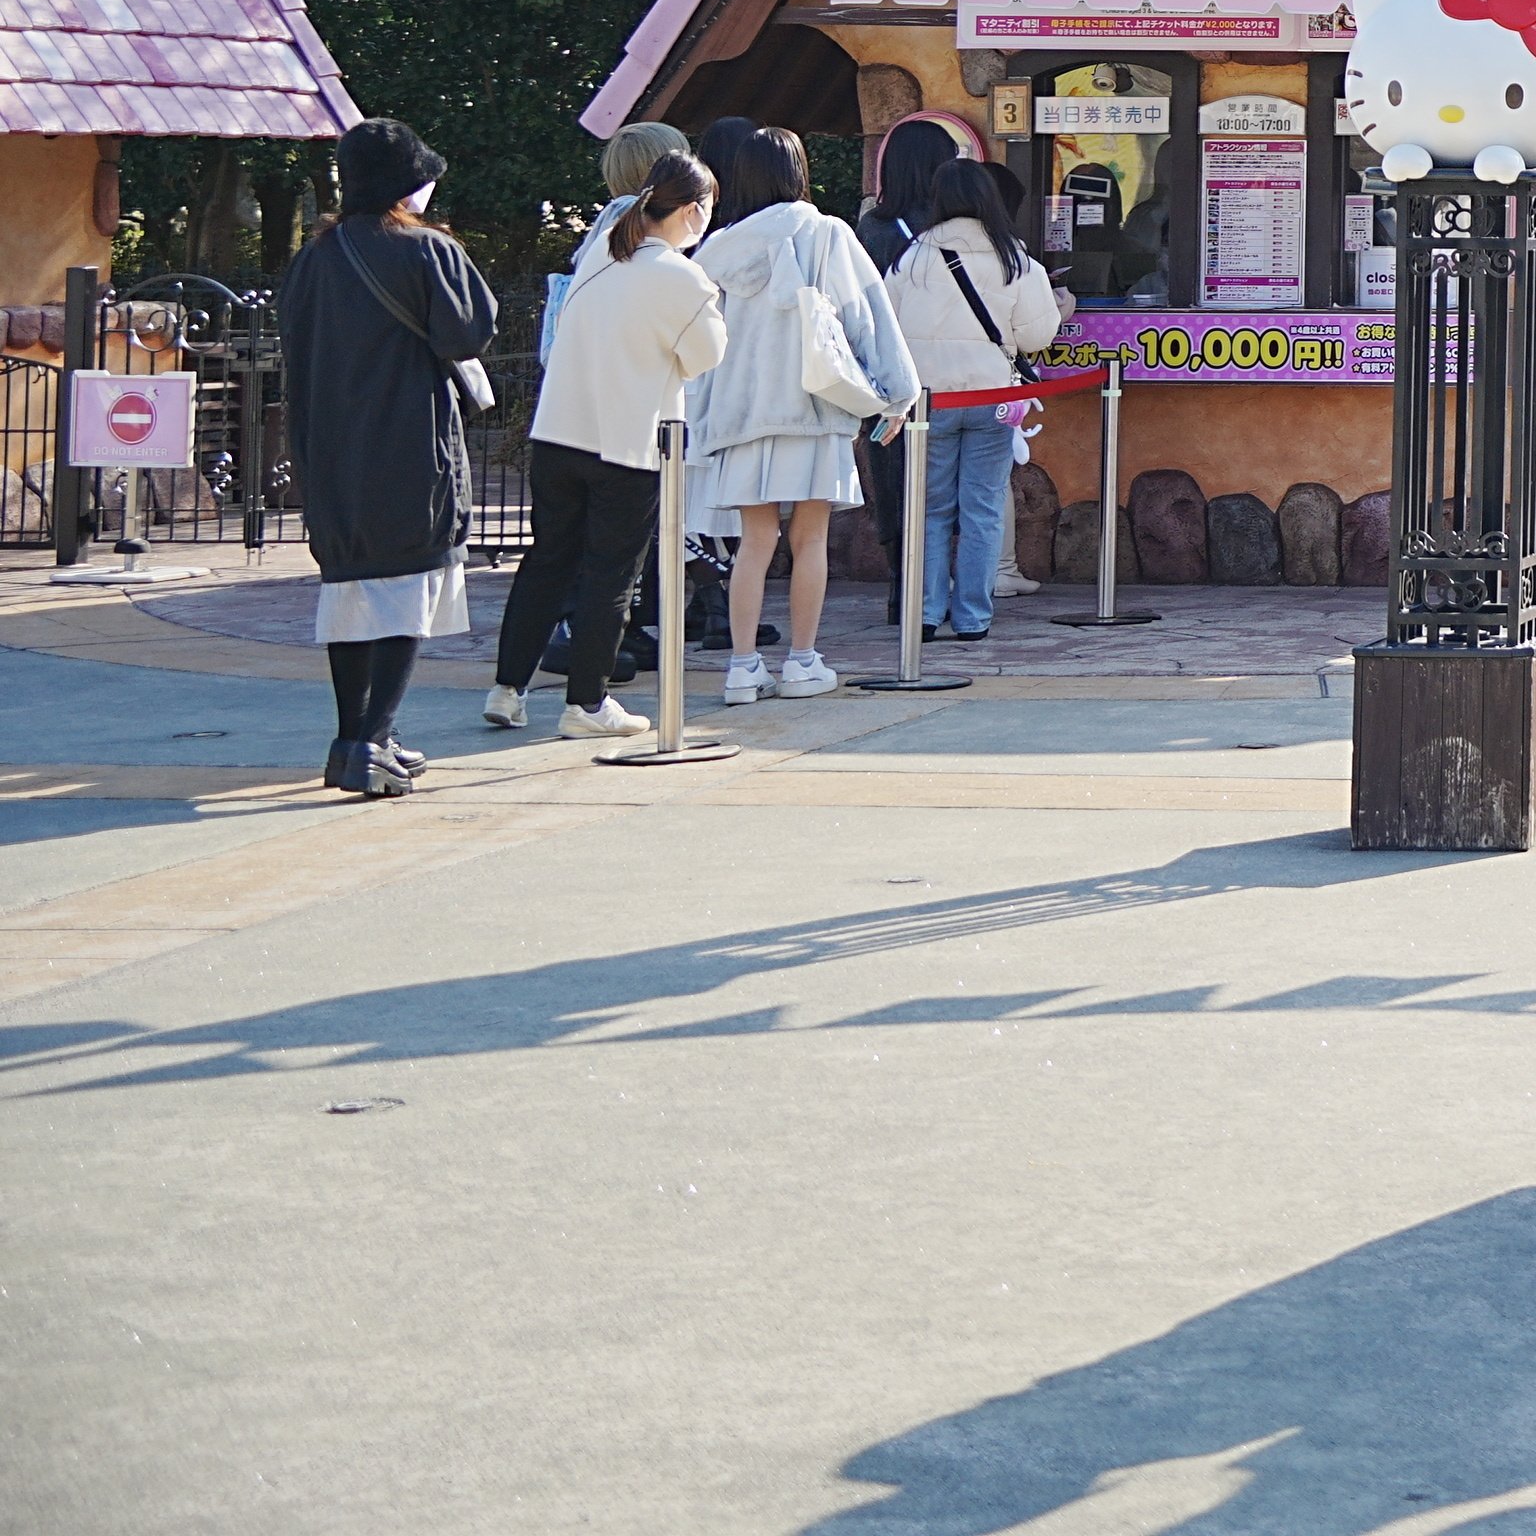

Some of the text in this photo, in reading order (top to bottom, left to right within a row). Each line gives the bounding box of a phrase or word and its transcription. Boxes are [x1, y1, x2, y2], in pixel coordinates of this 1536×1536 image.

[1003, 102, 1017, 124] 3
[1227, 102, 1278, 113] 営業時間
[1043, 104, 1161, 124] 当日券発売中
[1366, 272, 1395, 283] clos
[1361, 347, 1395, 359] お買い
[94, 446, 168, 457] DO NOT ENTER
